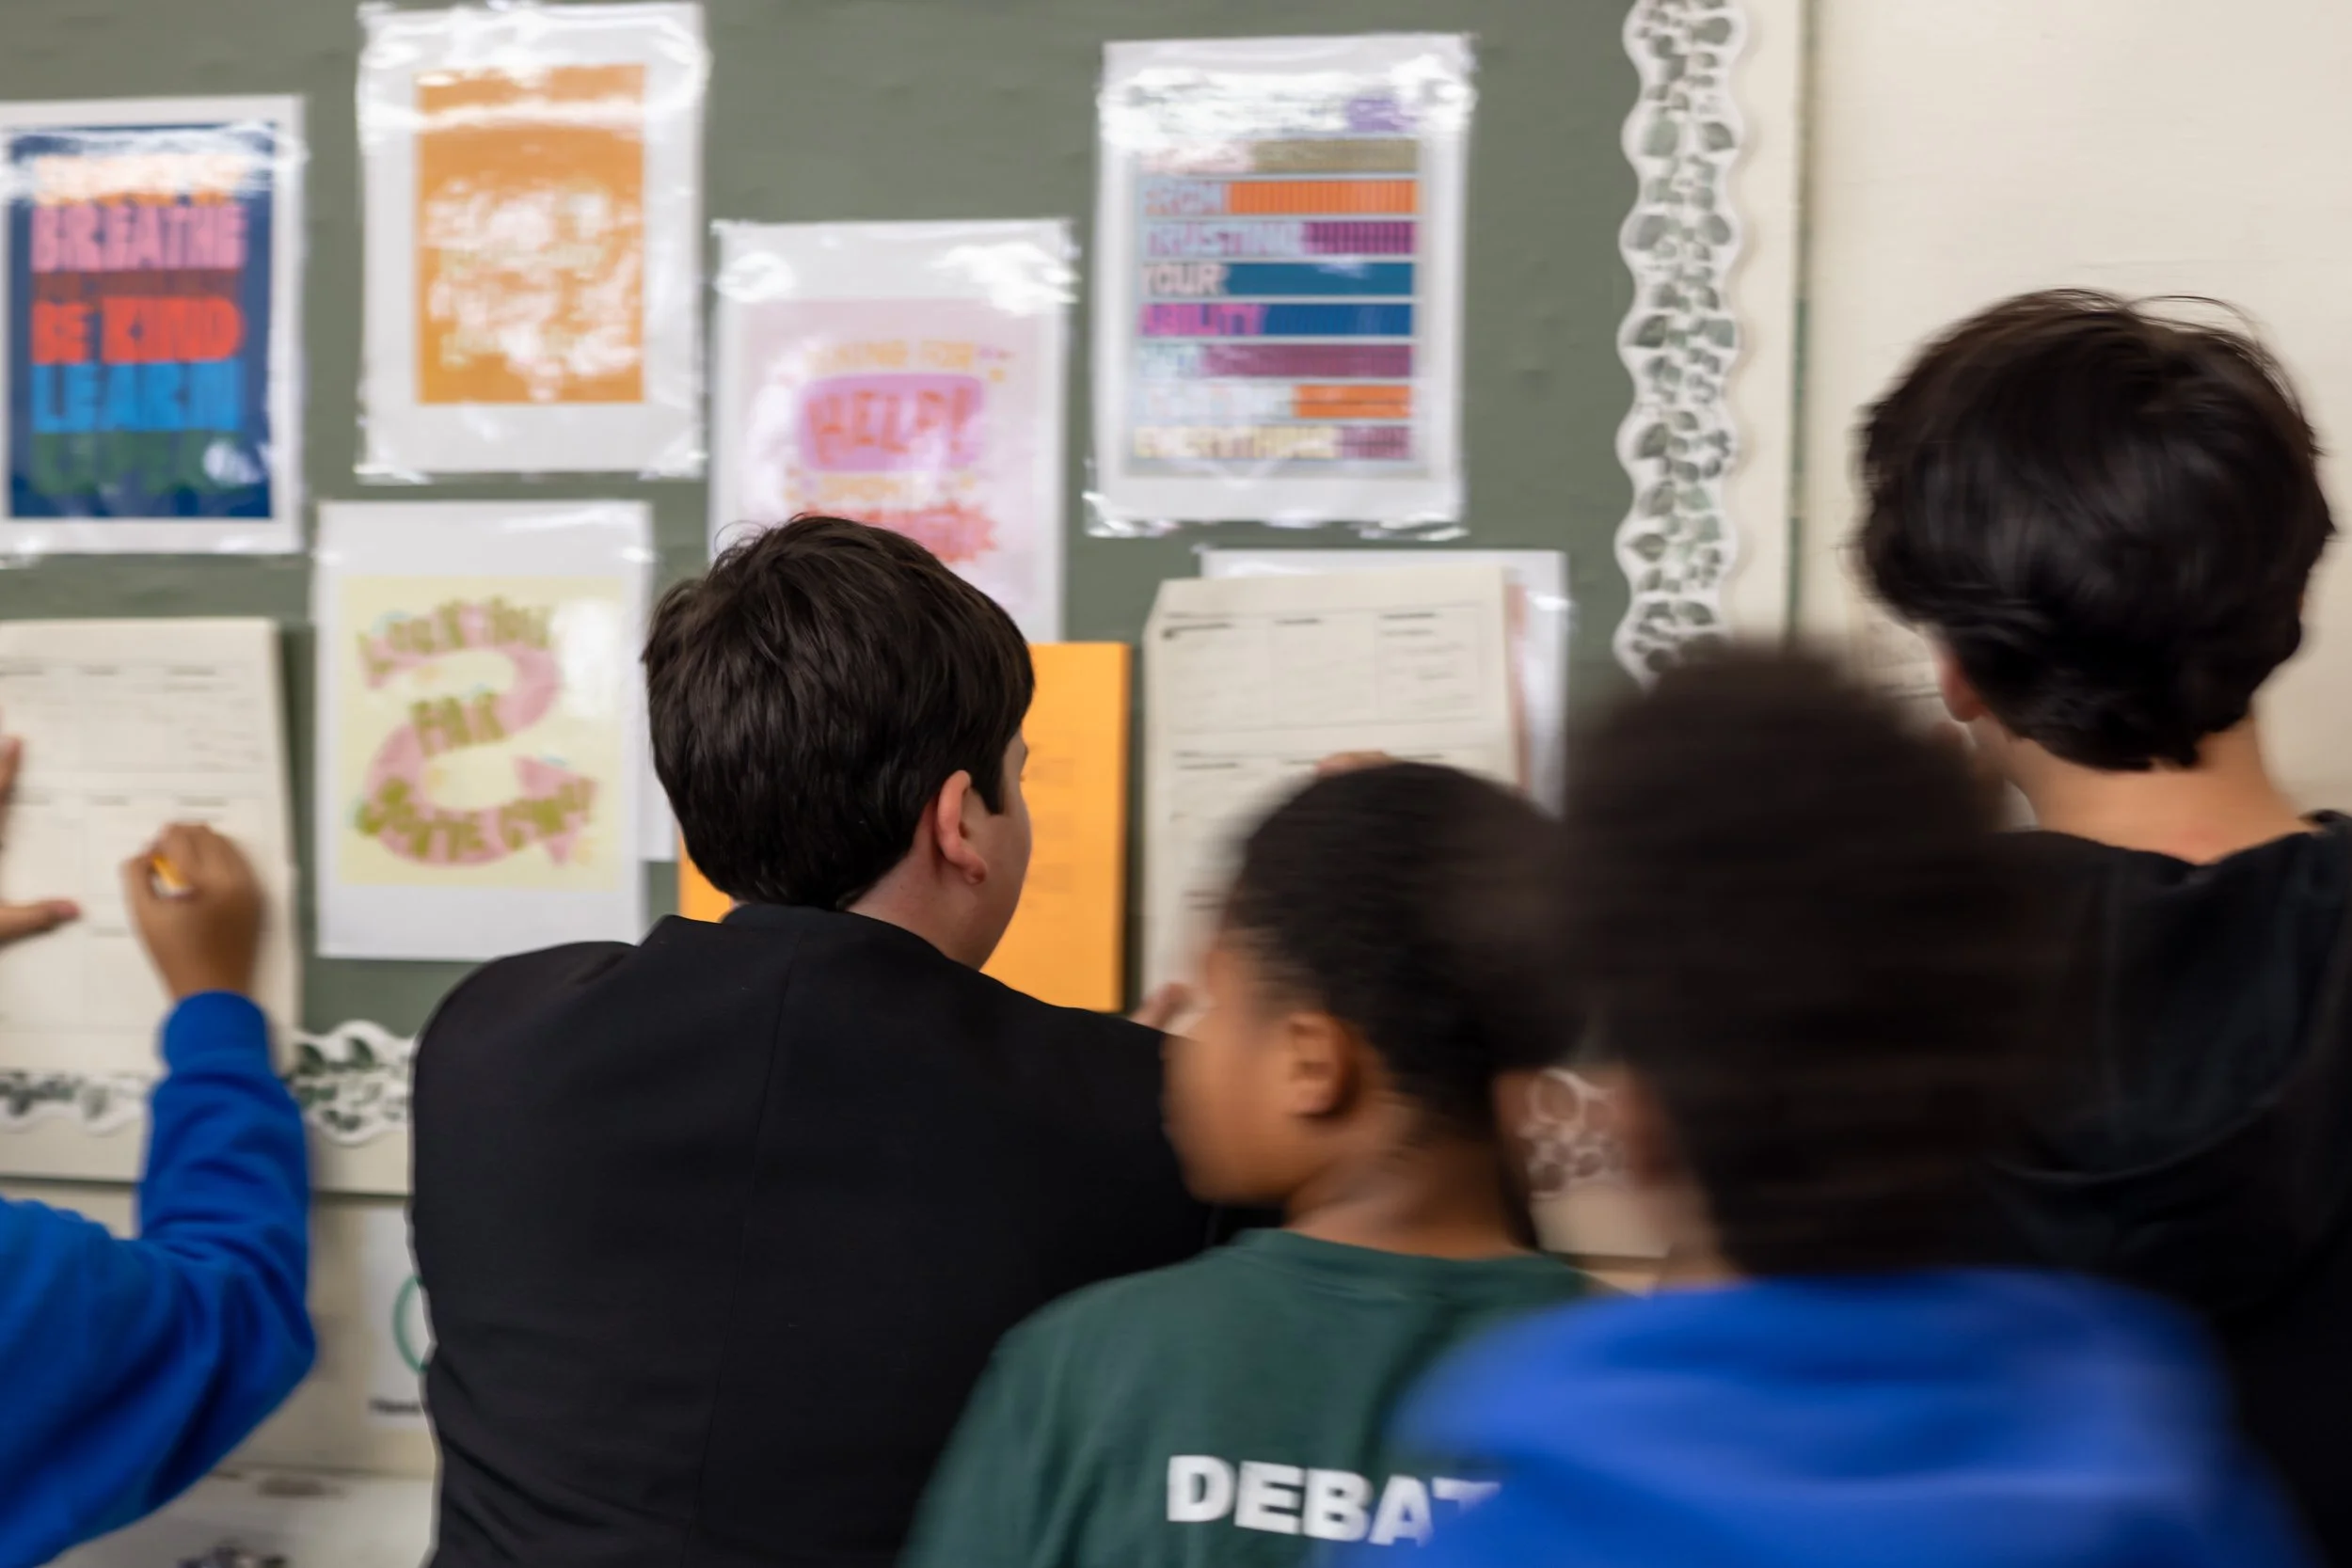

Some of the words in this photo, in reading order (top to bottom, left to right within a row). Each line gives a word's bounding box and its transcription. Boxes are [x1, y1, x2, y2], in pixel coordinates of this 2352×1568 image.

[31, 204, 246, 272] BREATHE
[1140, 261, 1231, 297] YOUR
[31, 303, 92, 365] BE
[101, 296, 244, 365] KIND
[33, 357, 243, 433] LEARN
[806, 386, 973, 465] HELP!
